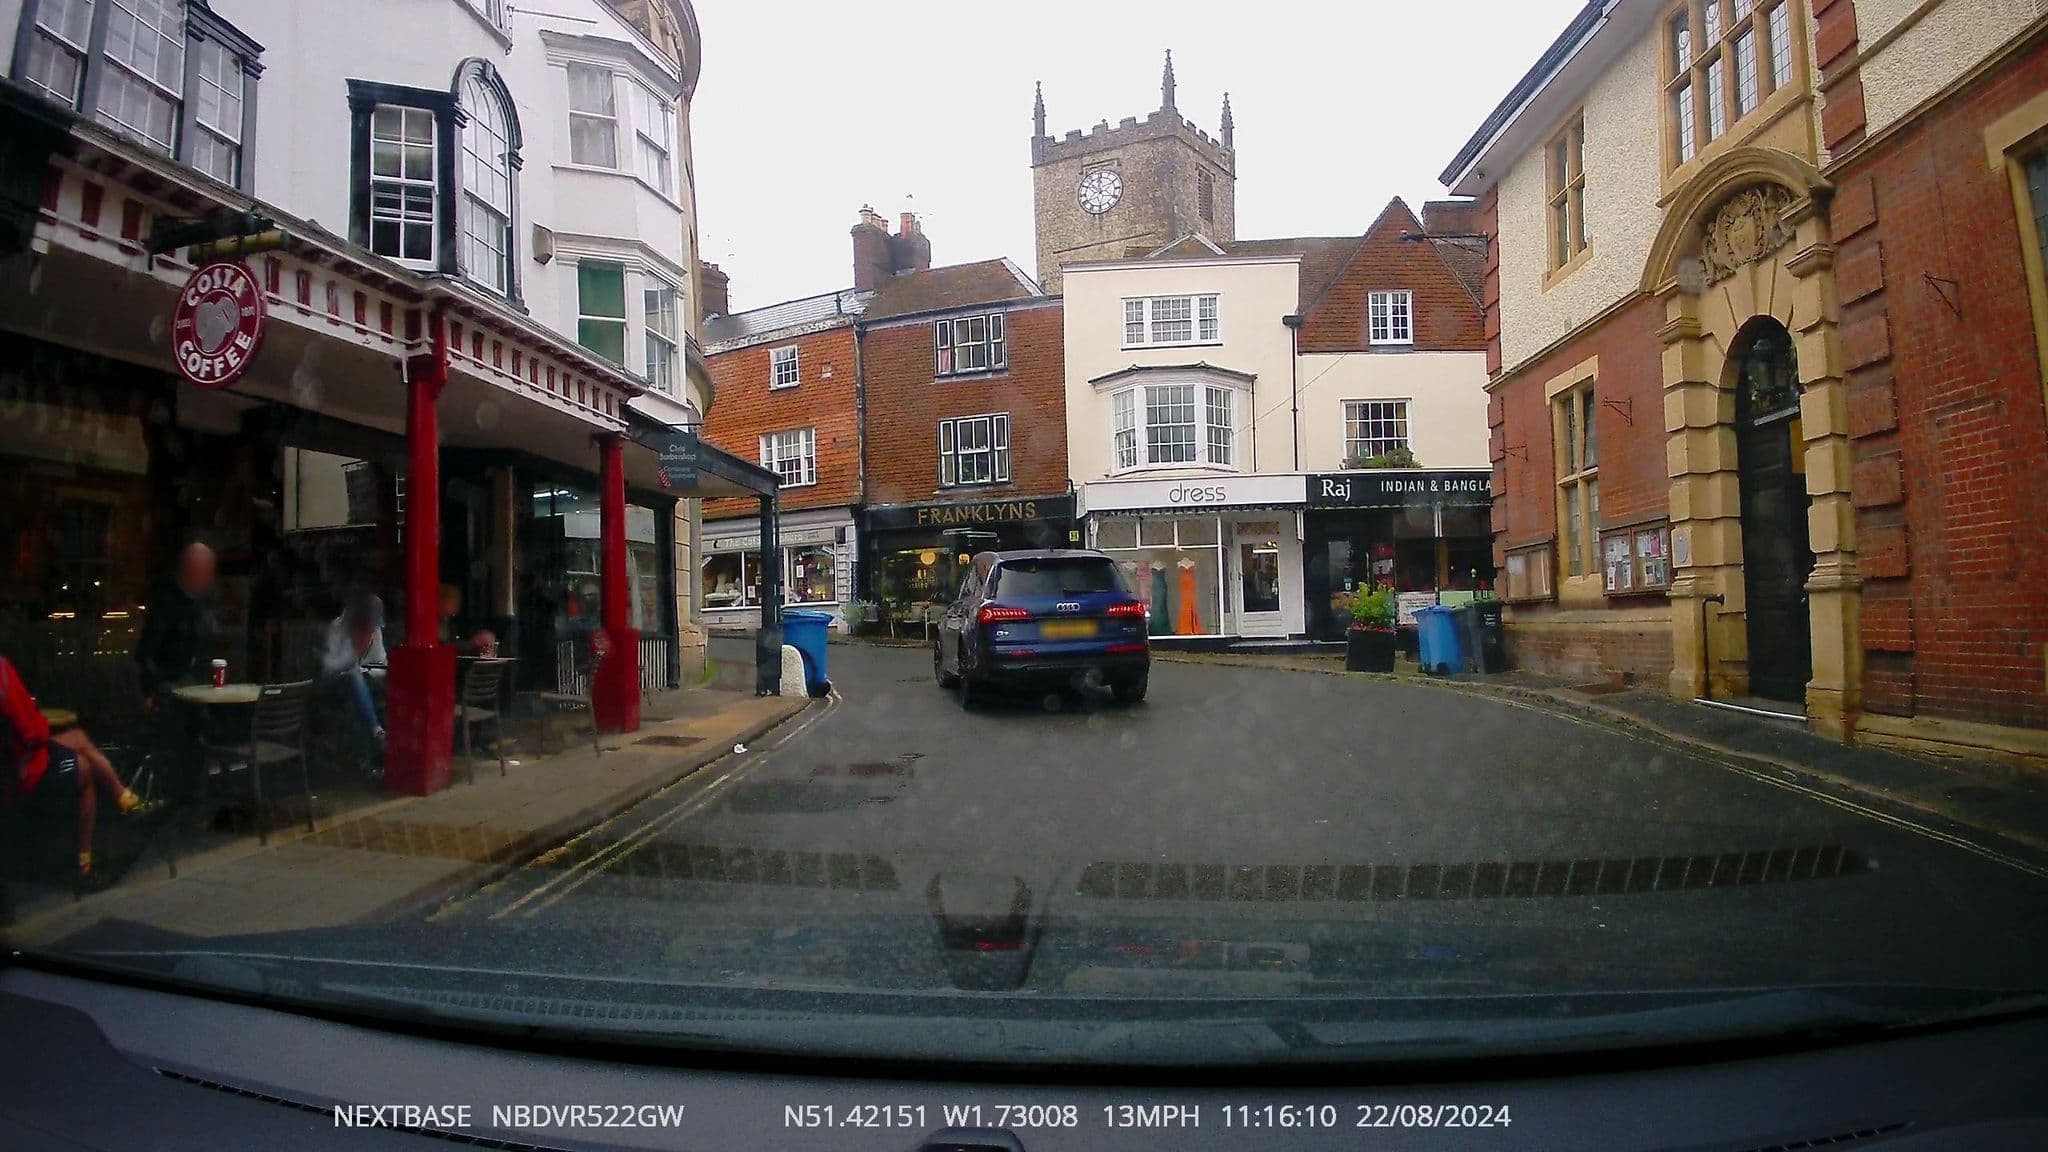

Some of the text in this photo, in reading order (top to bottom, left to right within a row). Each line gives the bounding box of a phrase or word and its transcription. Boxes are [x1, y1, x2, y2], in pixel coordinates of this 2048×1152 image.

[187, 268, 246, 306] COSTA
[180, 331, 251, 378] COFFEE
[1169, 482, 1226, 502] dress
[1321, 479, 1351, 501] Raj
[1381, 480, 1425, 492] INDIAN
[1430, 480, 1439, 492] &
[918, 502, 1036, 525] FRANKLYNS
